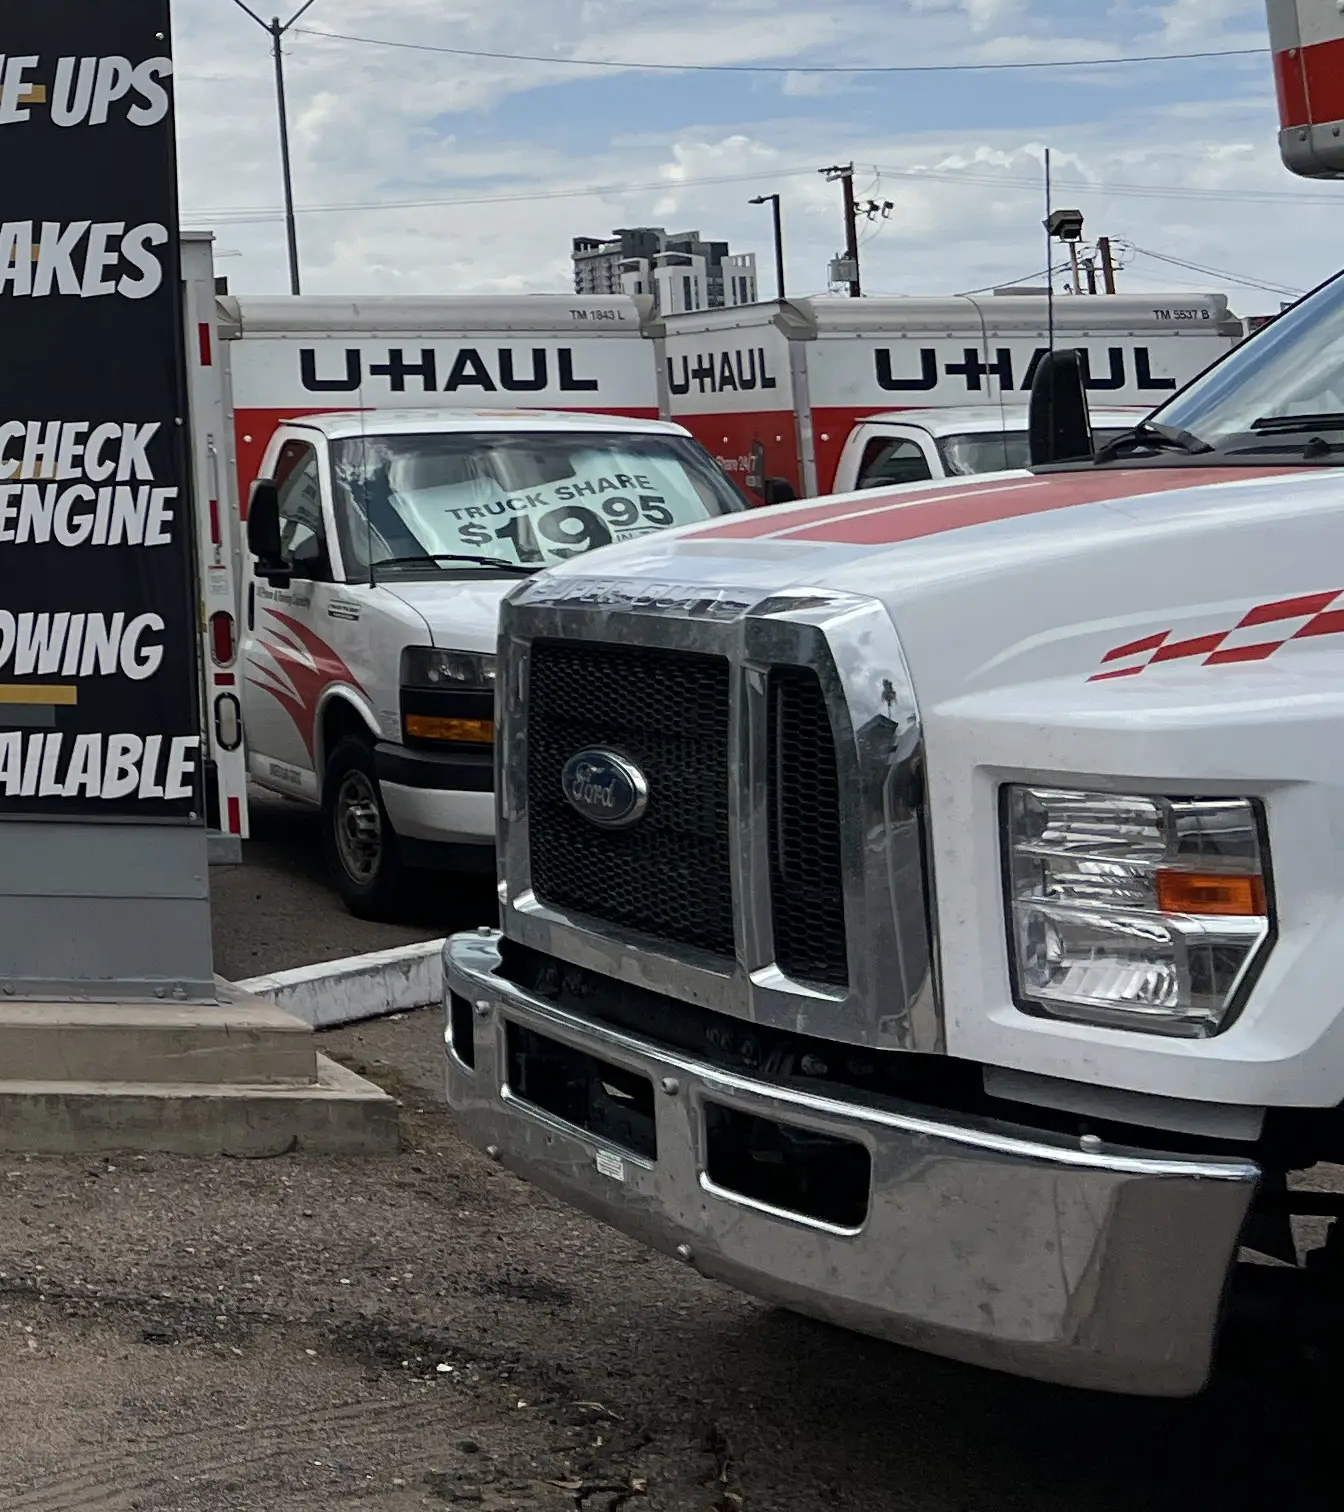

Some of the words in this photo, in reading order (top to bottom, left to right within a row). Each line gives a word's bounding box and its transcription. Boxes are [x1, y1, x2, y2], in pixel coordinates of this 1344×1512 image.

[50, 55, 173, 127] UPS
[1152, 309, 1171, 320] TM
[1200, 309, 1210, 320] B
[299, 348, 599, 392] U-HAUL
[666, 347, 776, 395] U-HAUL
[444, 491, 550, 521] TRUCK
[554, 472, 657, 502] SHARE
[572, 761, 617, 808] Ford
